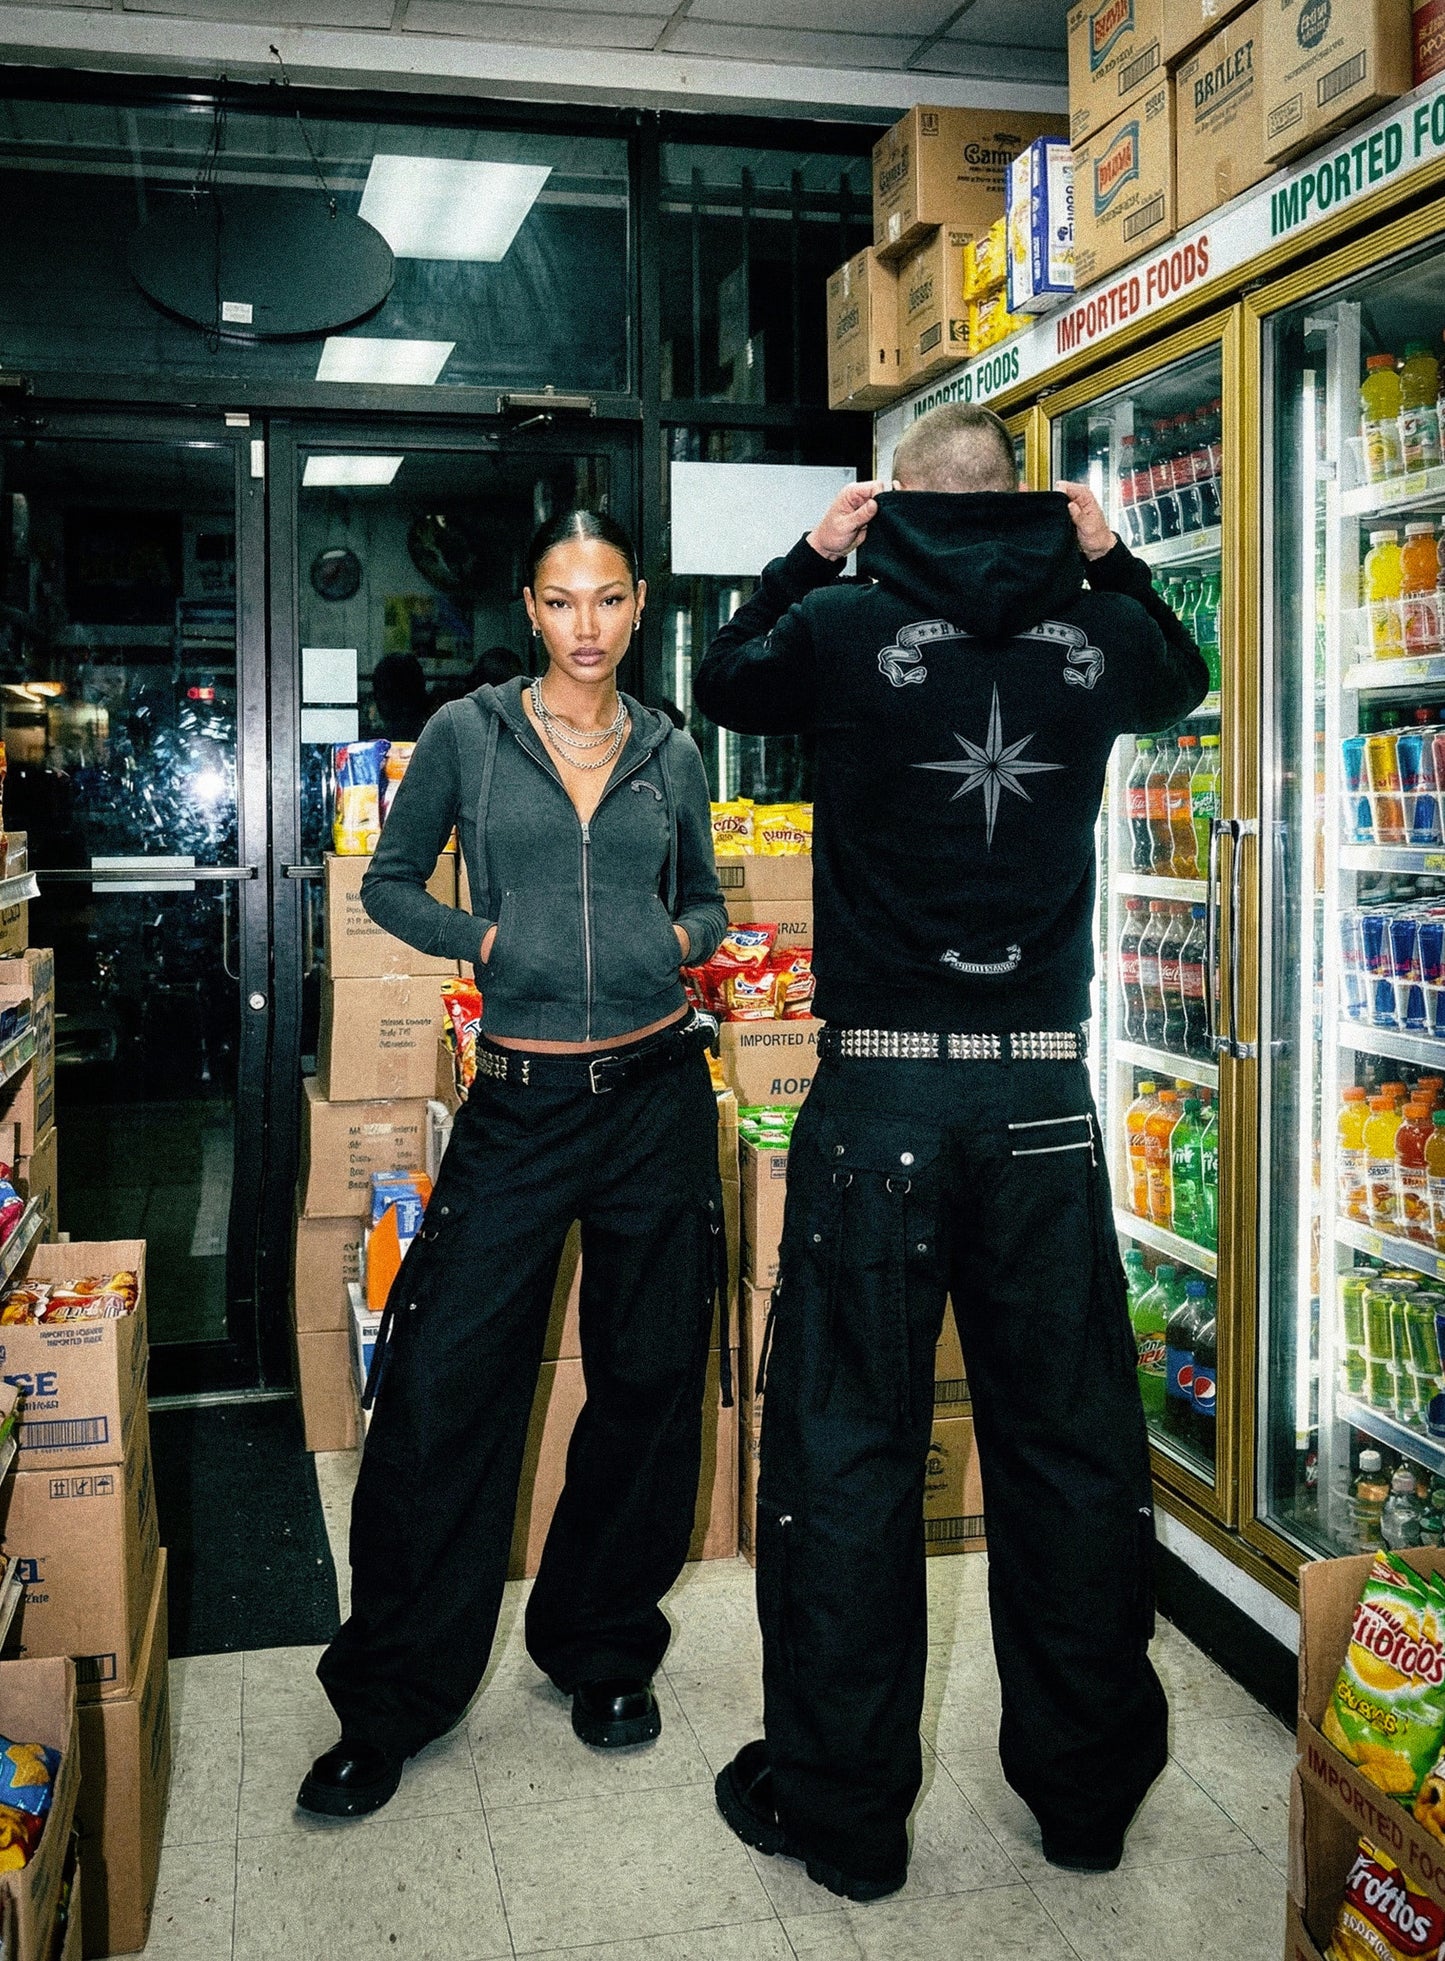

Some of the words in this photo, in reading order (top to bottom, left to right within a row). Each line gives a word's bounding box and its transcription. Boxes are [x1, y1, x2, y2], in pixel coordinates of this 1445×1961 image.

[1271, 122, 1403, 237] IMPORTED
[1056, 277, 1141, 354] IMPORTED
[1146, 235, 1210, 306] FOODS
[977, 346, 1019, 399] FOODS
[740, 1033, 804, 1048] IMPORTED
[1307, 1744, 1404, 1851] IMPORTED
